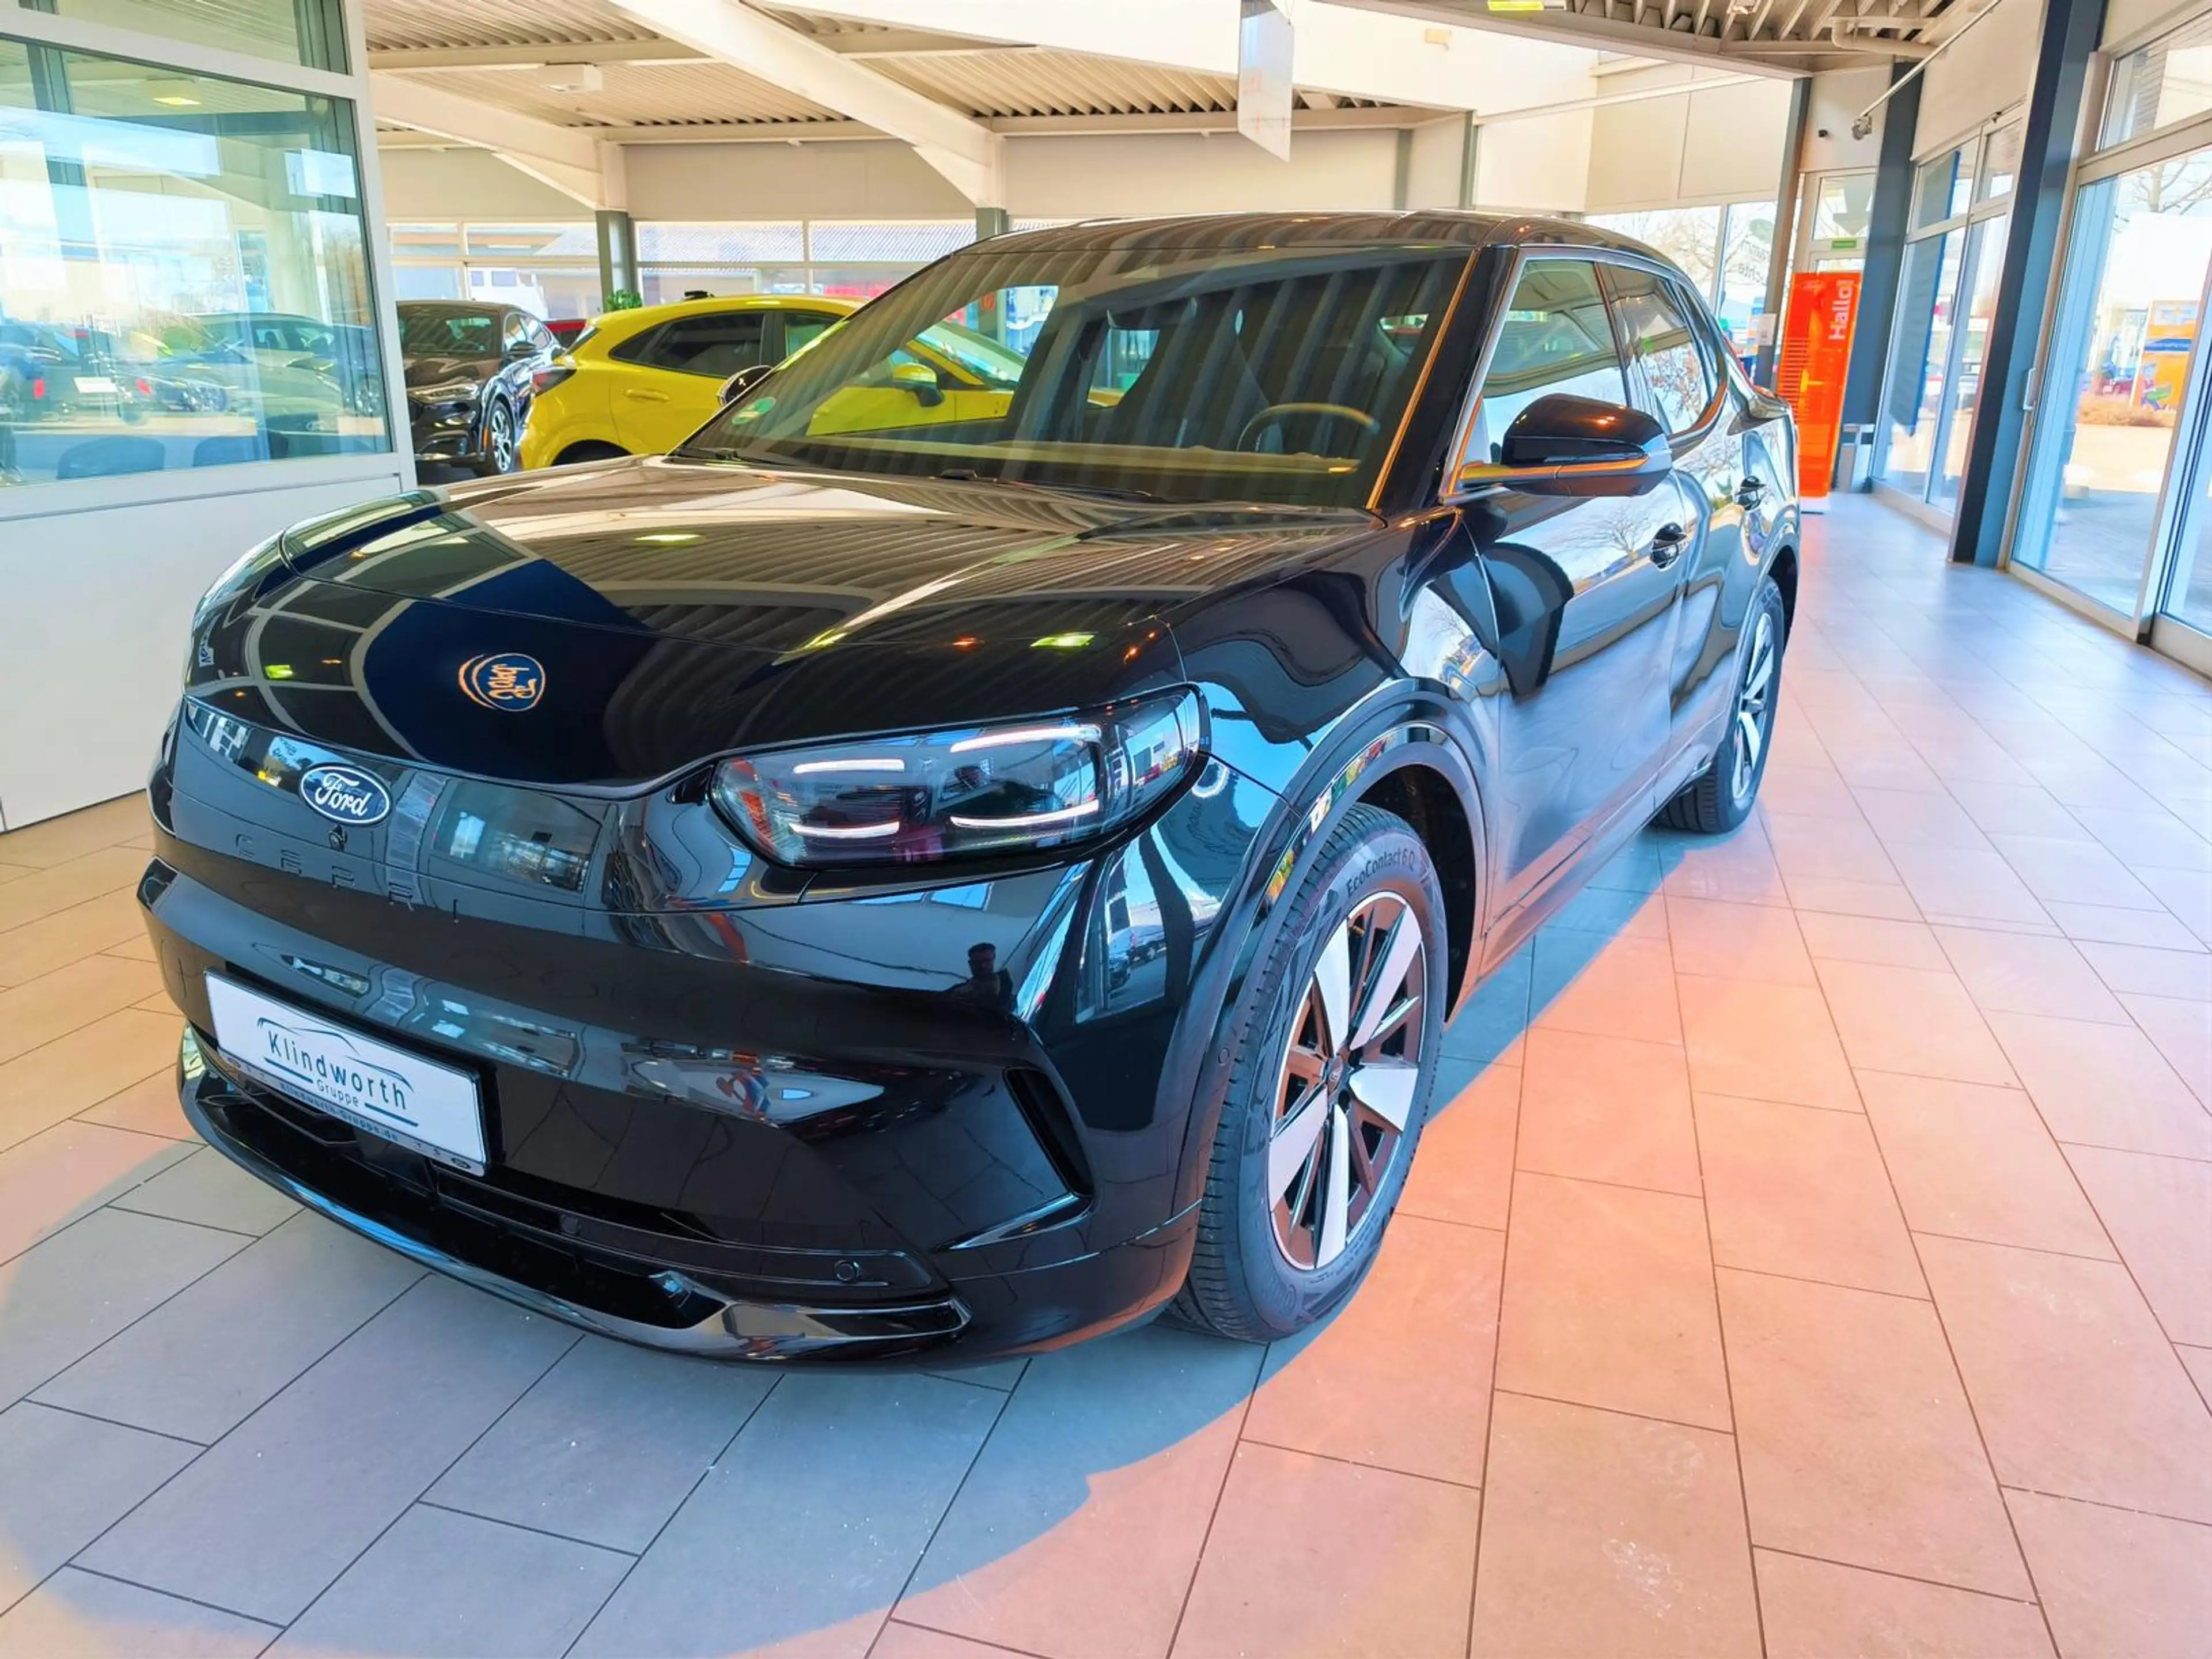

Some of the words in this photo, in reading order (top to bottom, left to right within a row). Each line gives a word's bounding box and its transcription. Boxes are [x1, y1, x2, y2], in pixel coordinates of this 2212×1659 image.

[1828, 279, 1855, 340] Hallo!
[315, 772, 373, 817] Ford
[1346, 847, 1401, 898] EcoContact
[267, 1030, 407, 1111] Klindworth
[316, 1078, 360, 1108] Gruppe
